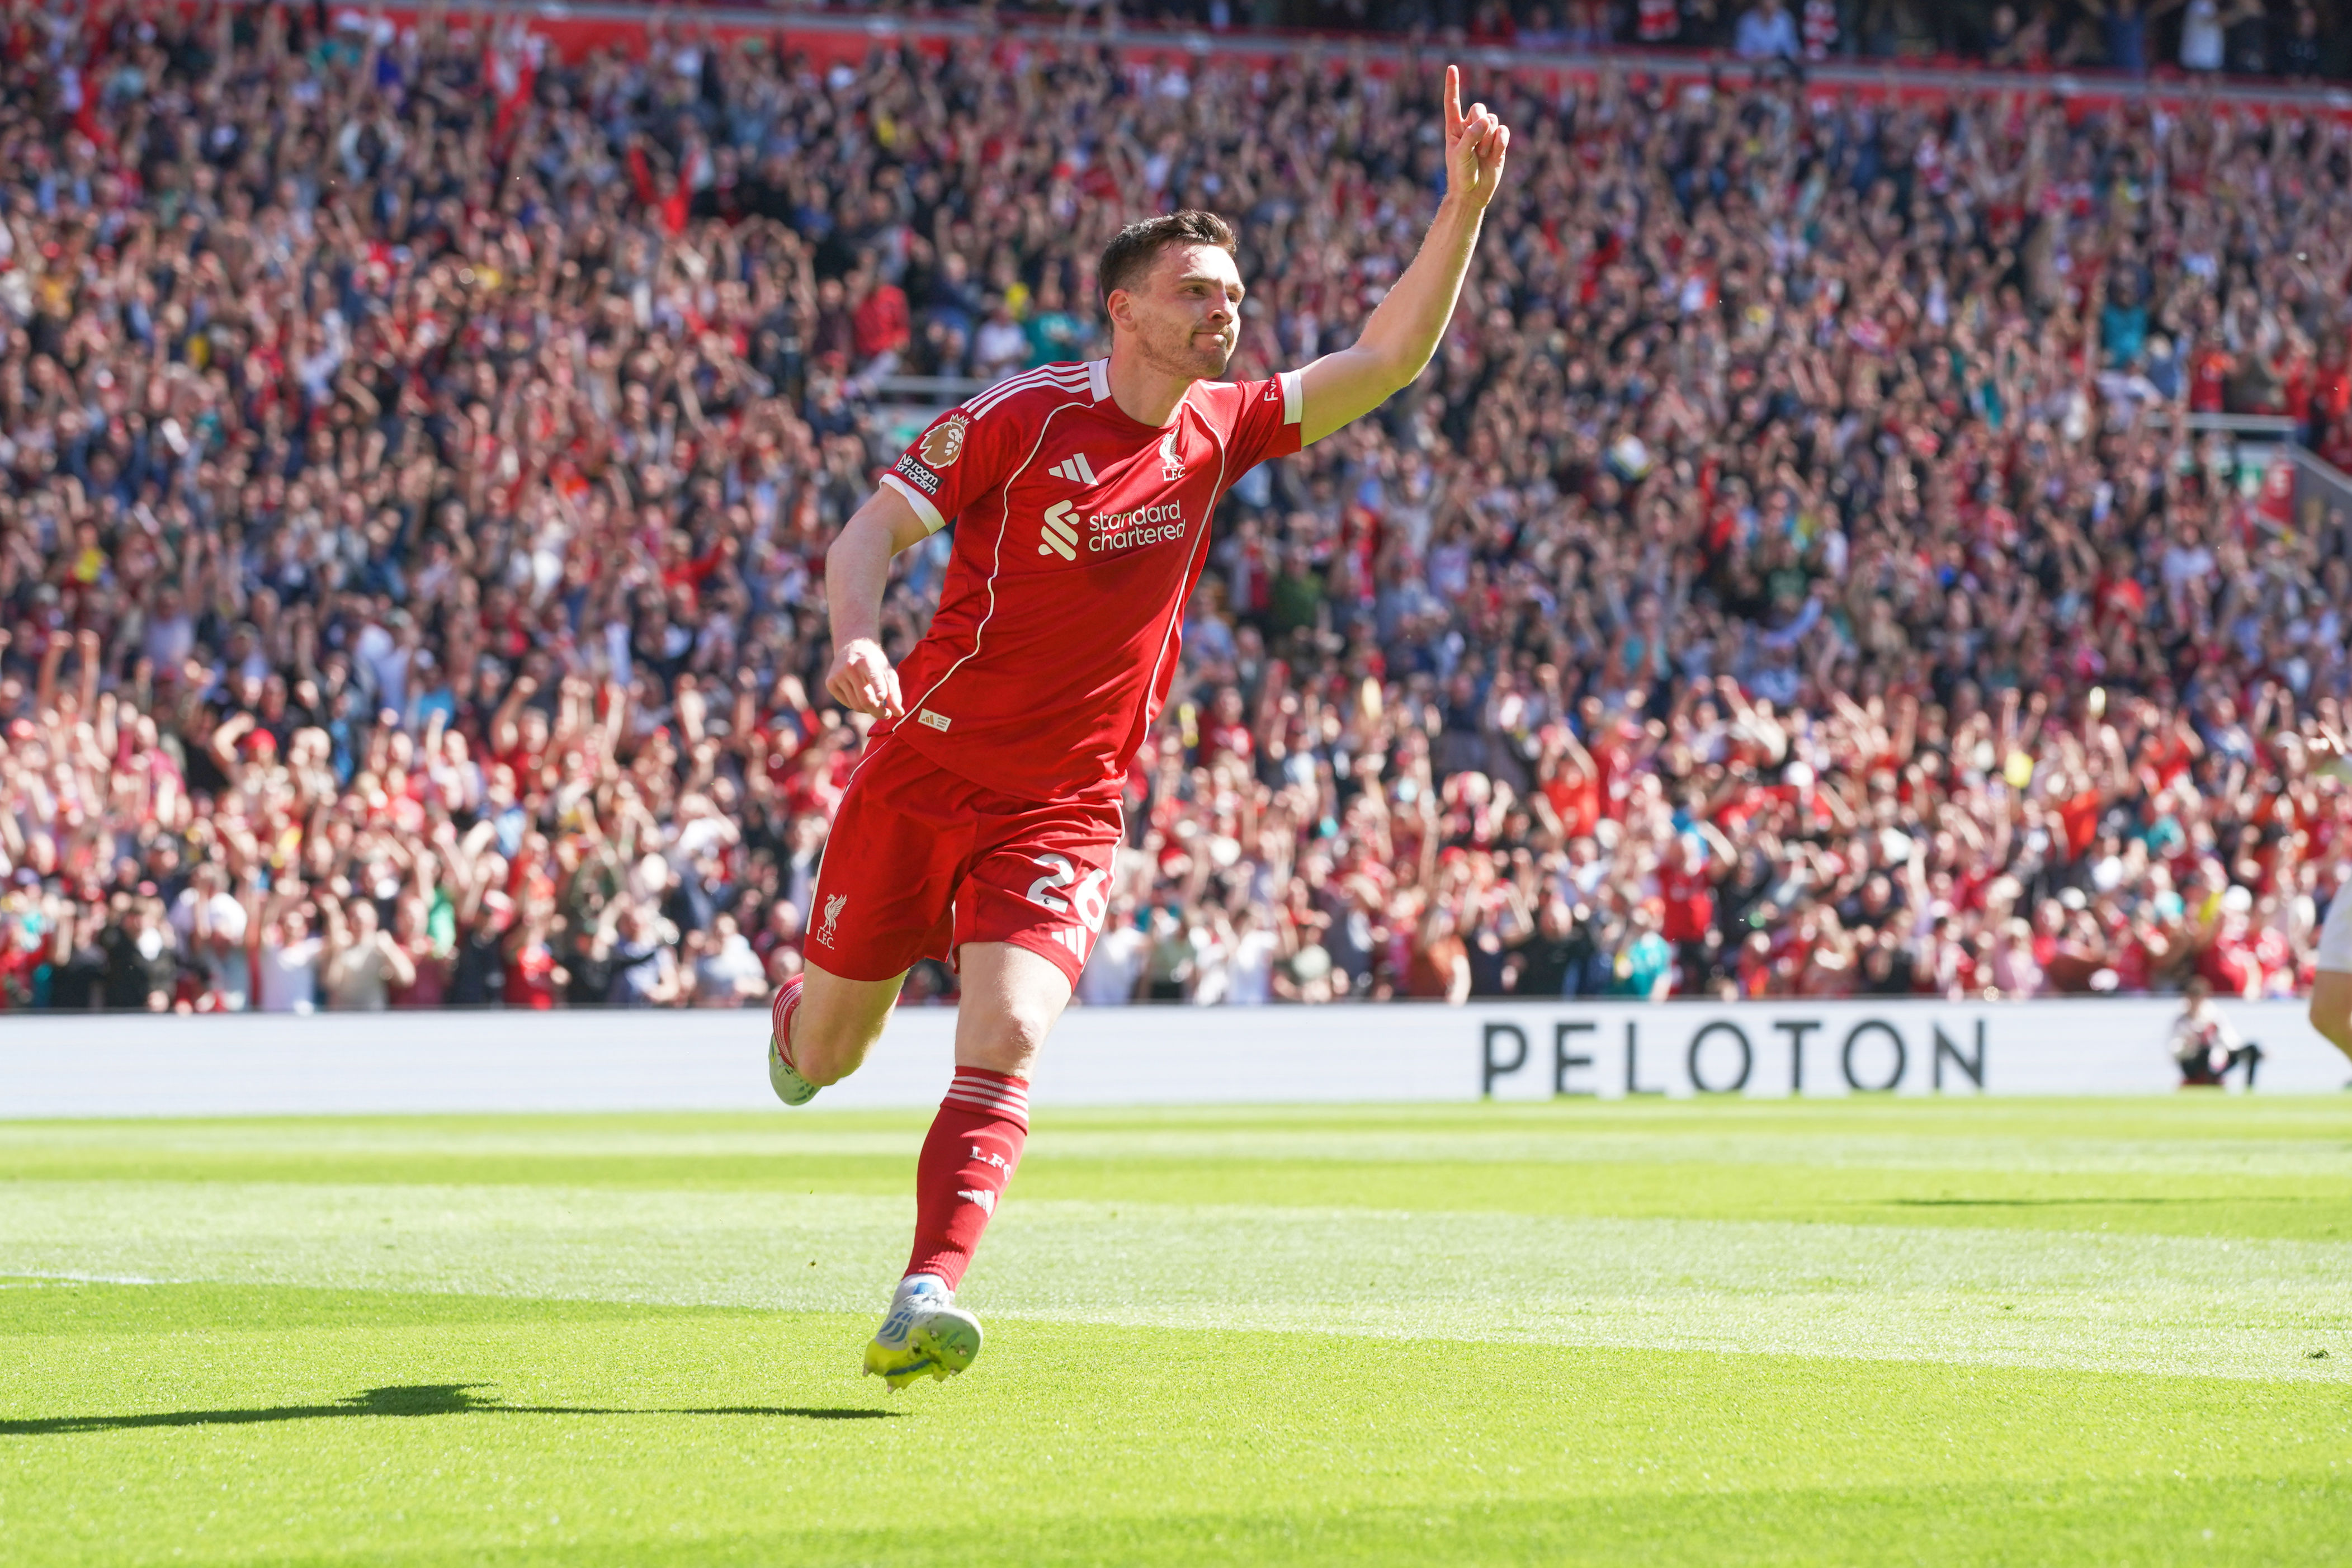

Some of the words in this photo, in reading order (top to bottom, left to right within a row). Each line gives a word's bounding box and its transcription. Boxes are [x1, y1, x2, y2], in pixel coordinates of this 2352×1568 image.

[895, 461, 907, 472] for
[904, 468, 937, 495] racism
[899, 454, 913, 465] No
[911, 462, 938, 485] room
[1089, 499, 1180, 531] standard
[1089, 518, 1186, 552] chartered
[1026, 853, 1106, 933] 26
[816, 929, 835, 950] L.F.C.
[1482, 1019, 1986, 1095] PELOTON
